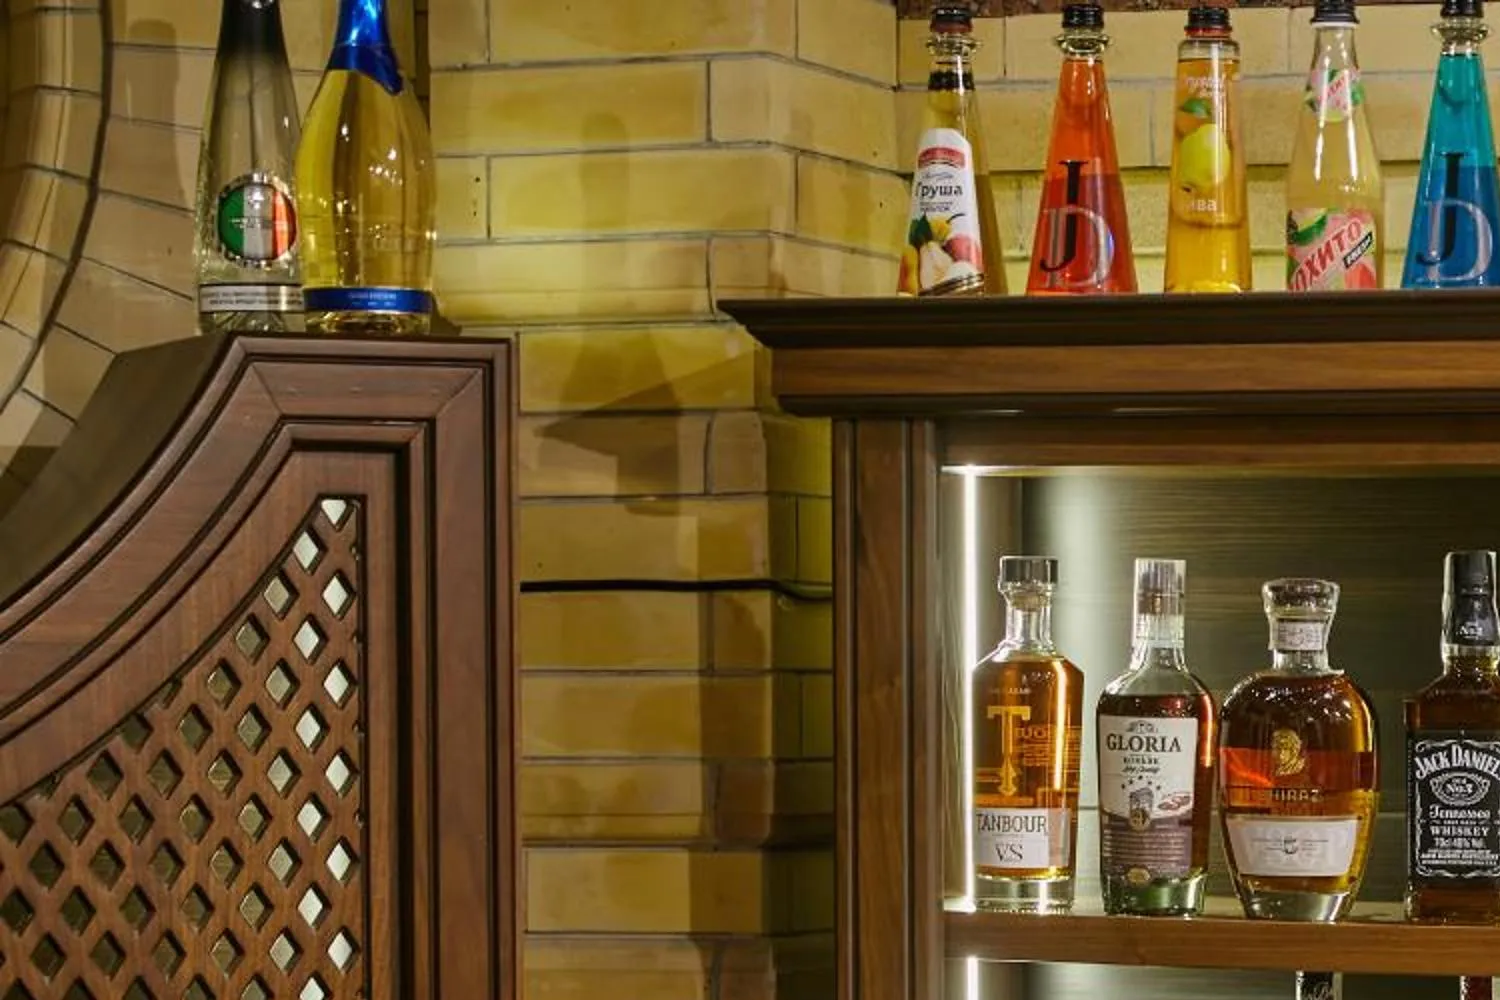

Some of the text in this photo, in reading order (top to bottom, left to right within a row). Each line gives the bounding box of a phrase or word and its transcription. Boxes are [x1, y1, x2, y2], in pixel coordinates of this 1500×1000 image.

[914, 181, 963, 198] Груша
[1291, 219, 1362, 291] ОХИТО
[1106, 733, 1182, 754] GLORIA
[1414, 751, 1450, 779] JACK
[976, 813, 1048, 836] TANBOUR
[1430, 826, 1489, 837] WHISKEY
[995, 843, 1024, 862] VS
